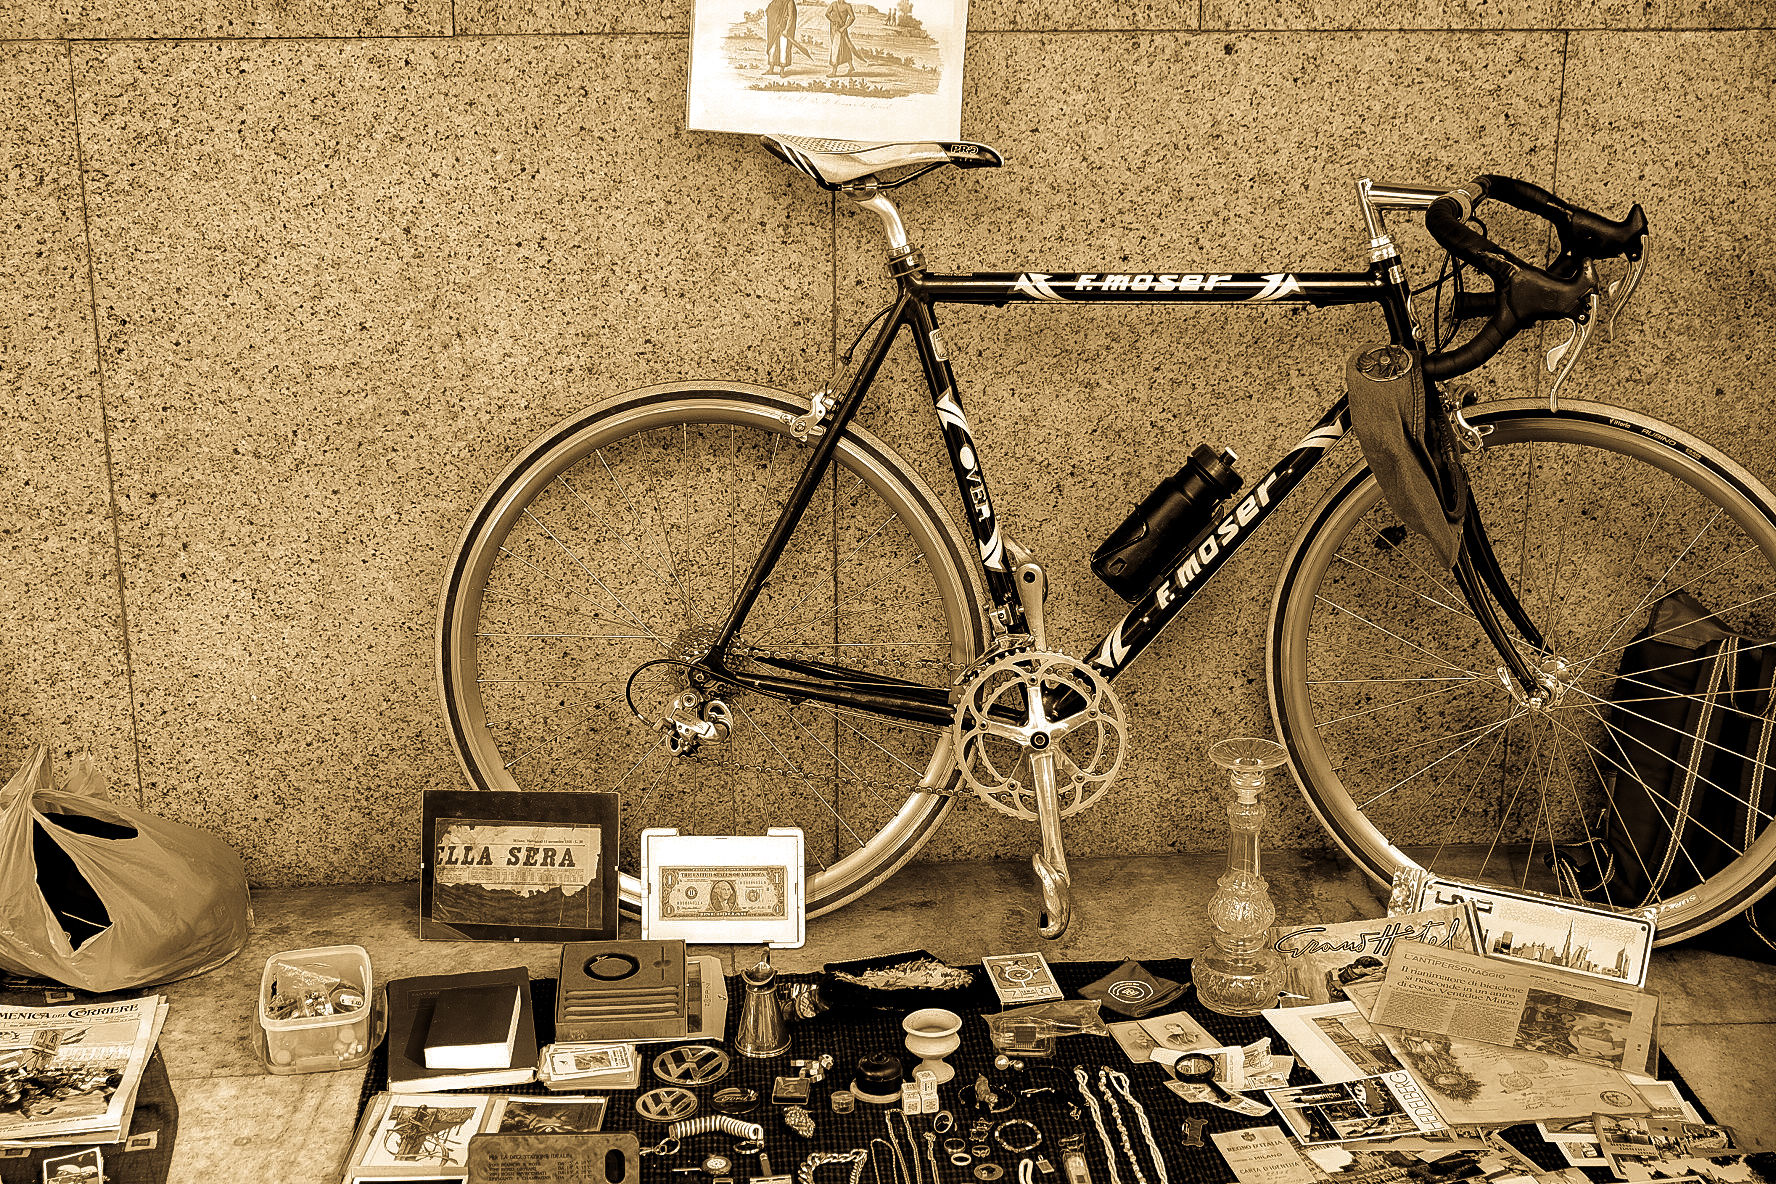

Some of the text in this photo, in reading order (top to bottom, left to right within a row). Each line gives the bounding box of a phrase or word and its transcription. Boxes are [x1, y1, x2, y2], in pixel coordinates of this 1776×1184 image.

[1609, 418, 1677, 446] Vittoria RUBINO
[506, 846, 576, 867] SERA
[1404, 953, 1506, 979] L'ANTIPERSONAGGIO
[1397, 980, 1519, 1006] di corso Ventidue Marzo
[1410, 967, 1466, 984] rianimatore
[1467, 979, 1477, 987] di
[1480, 981, 1524, 994] biciclette
[1415, 977, 1461, 990] nasconde
[1489, 990, 1516, 999] antro
[68, 1004, 139, 1018] CORRIERE
[1389, 1073, 1445, 1130] HEIDELBERG
[1226, 1144, 1252, 1152] REGNO
